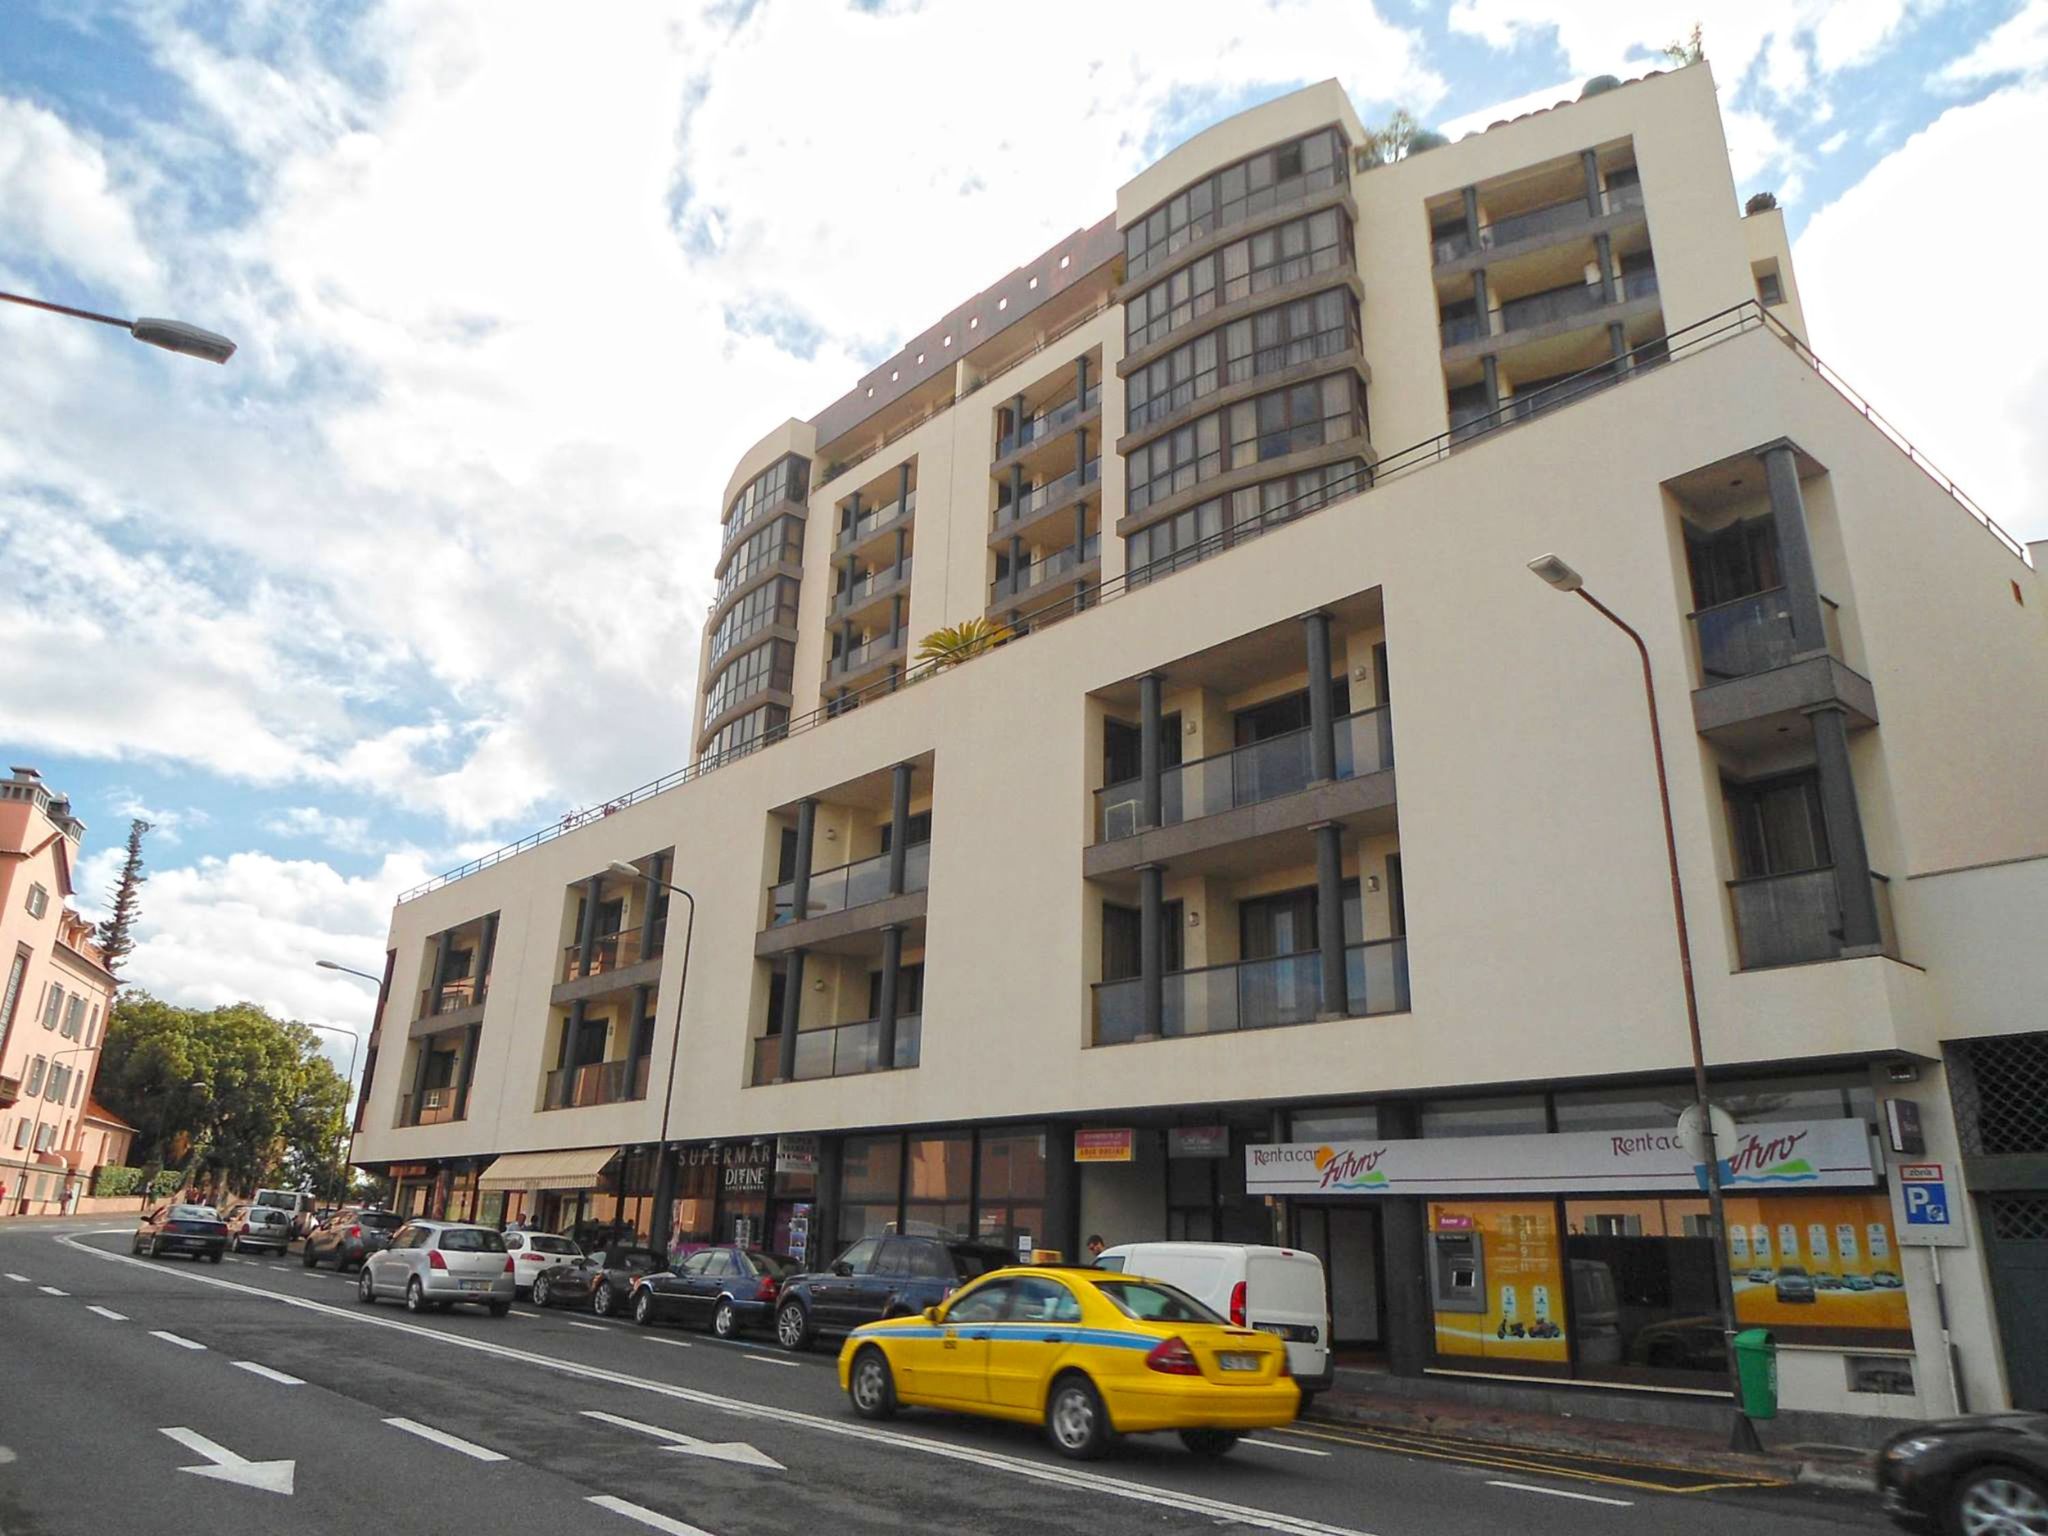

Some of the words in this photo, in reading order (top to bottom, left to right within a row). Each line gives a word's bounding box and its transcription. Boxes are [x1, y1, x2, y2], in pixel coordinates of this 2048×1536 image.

[1253, 1147, 1283, 1167] Rent
[1295, 1149, 1320, 1162] car
[1611, 1133, 1652, 1156] Rent
[1729, 1129, 1808, 1174] uturo
[725, 1167, 765, 1186] DIVINE
[1319, 1147, 1388, 1189] Futuro
[1906, 1187, 1931, 1214] P
